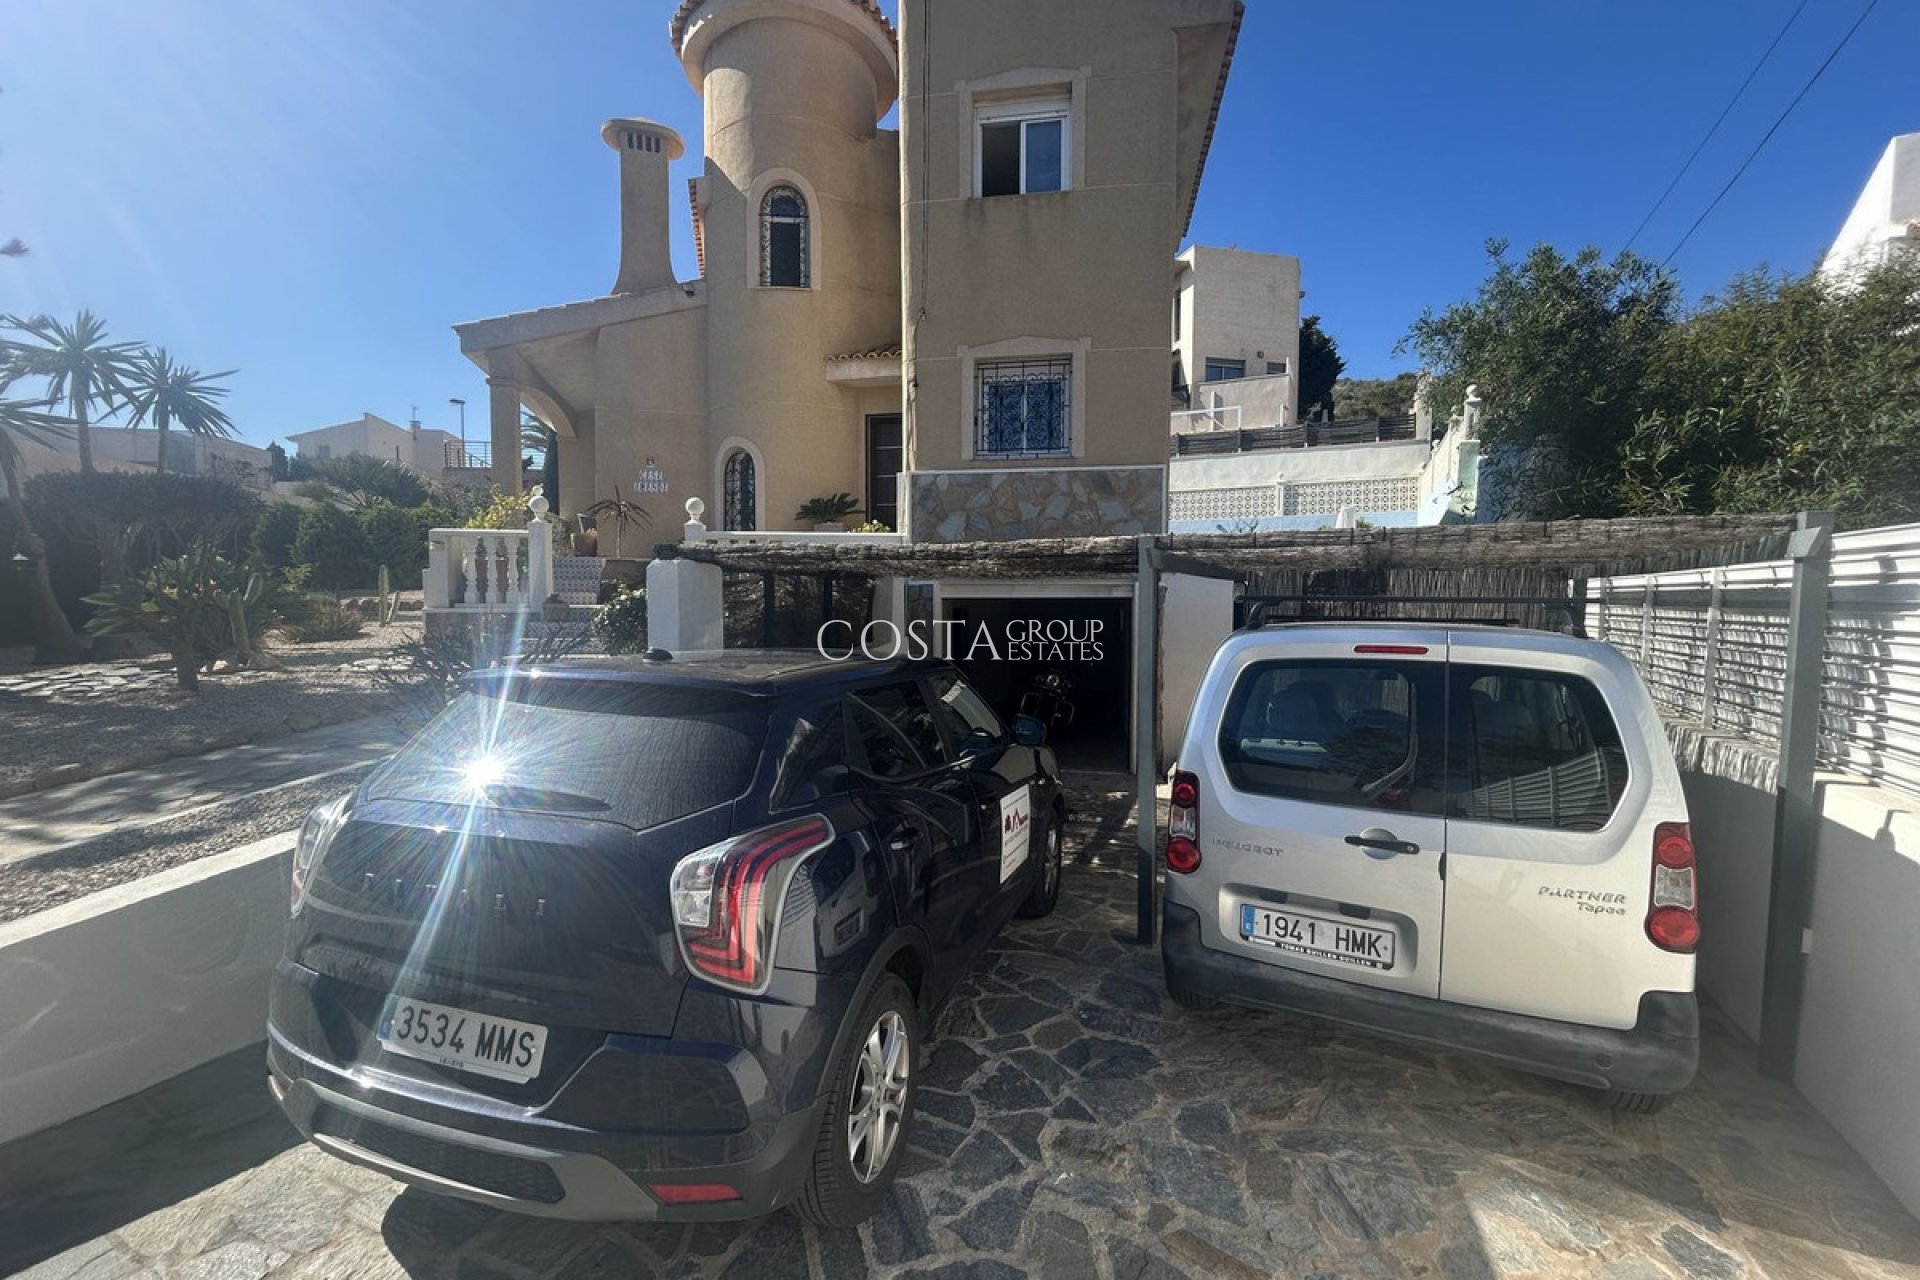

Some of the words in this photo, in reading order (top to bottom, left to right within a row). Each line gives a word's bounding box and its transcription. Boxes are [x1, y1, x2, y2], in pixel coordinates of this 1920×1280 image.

[1538, 885, 1626, 904] PARTNER
[1263, 914, 1316, 945] 1941
[1335, 927, 1383, 958] HMK
[397, 1005, 467, 1053] 3534
[475, 1022, 535, 1068] MMS
